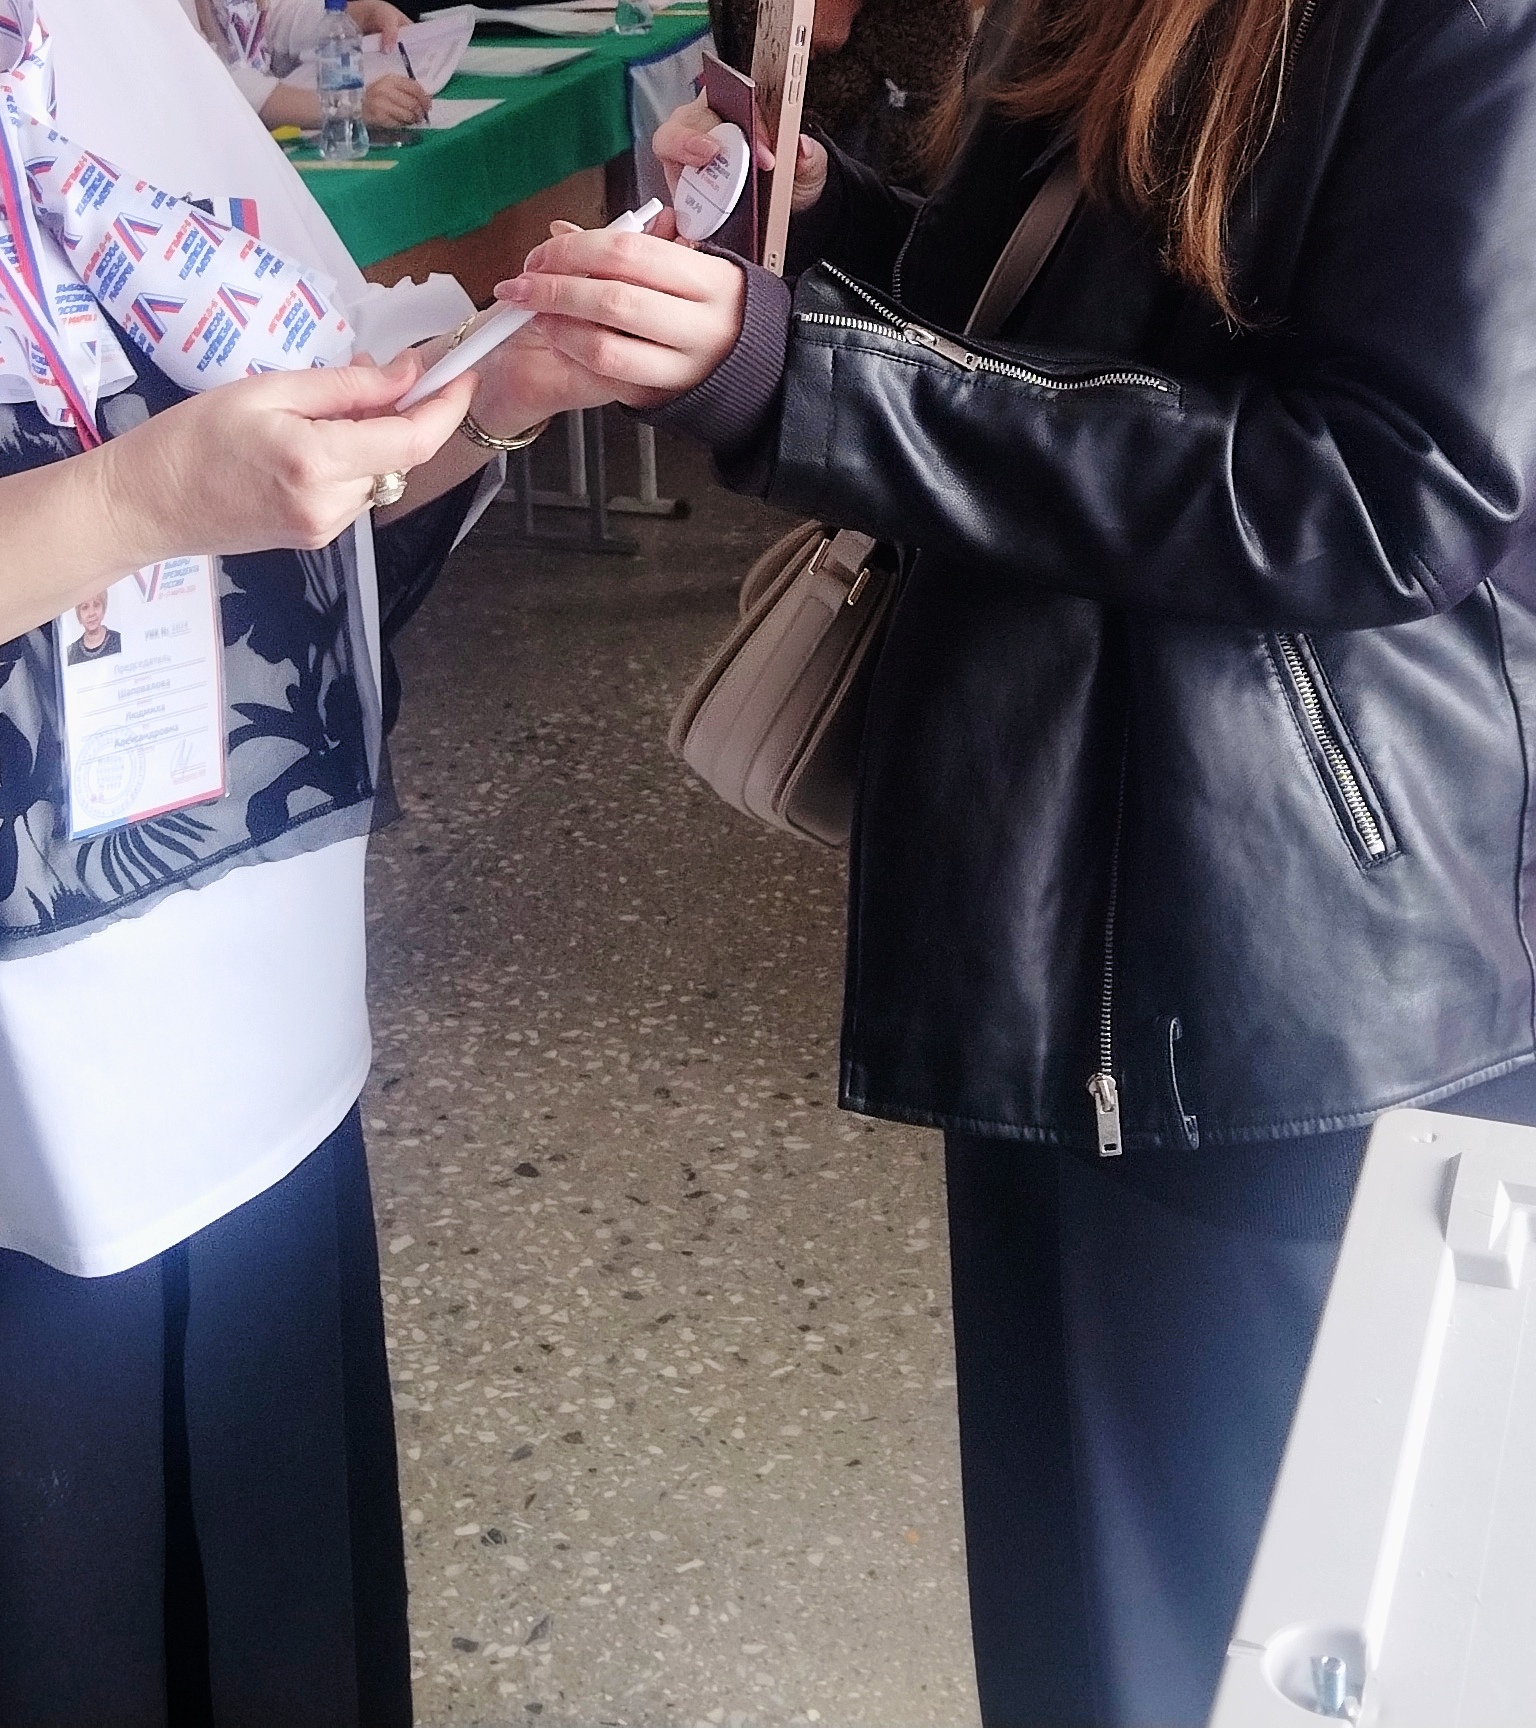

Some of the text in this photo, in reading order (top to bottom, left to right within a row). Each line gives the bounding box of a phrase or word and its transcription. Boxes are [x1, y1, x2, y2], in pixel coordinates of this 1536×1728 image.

[94, 239, 120, 278] РОССИИ
[196, 316, 234, 373] ПРЕЗИДЕНТА
[201, 306, 226, 344] РОССИИ
[214, 327, 241, 368] ВЫБОРЫ
